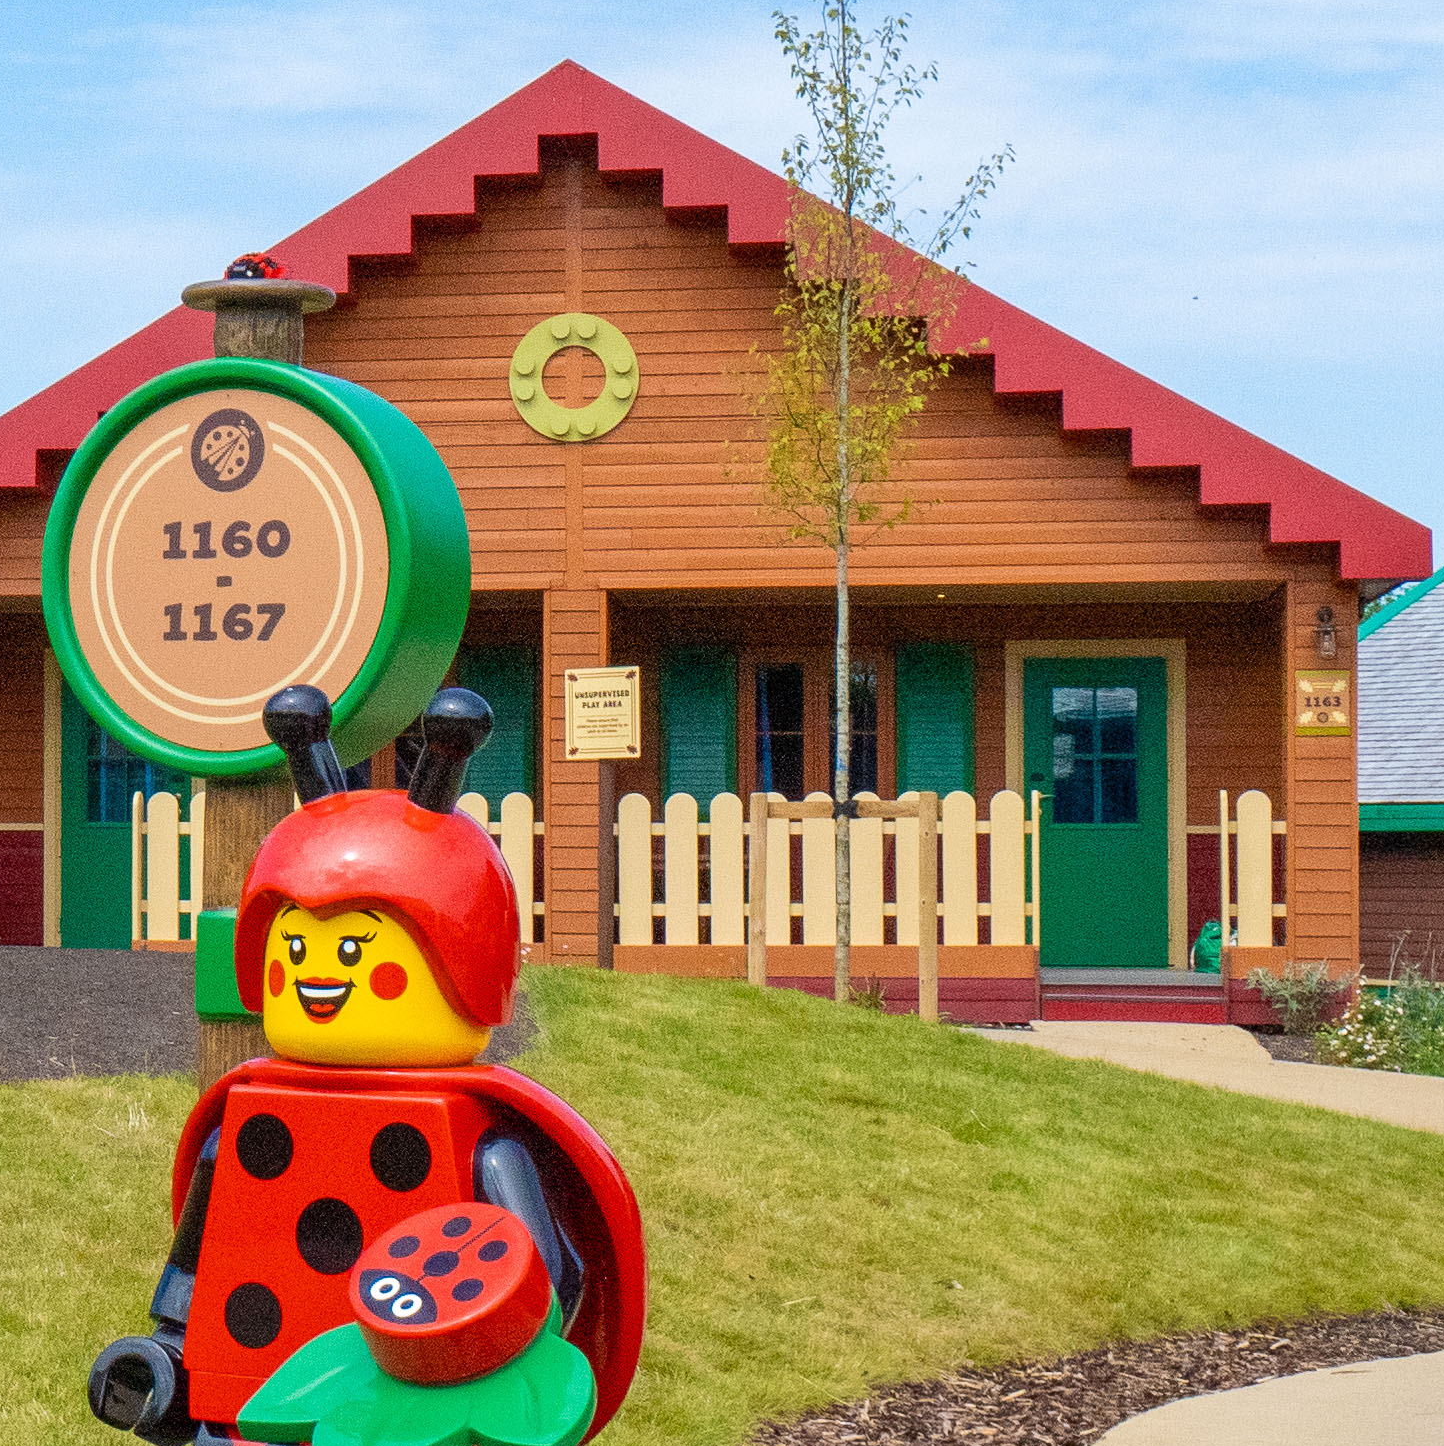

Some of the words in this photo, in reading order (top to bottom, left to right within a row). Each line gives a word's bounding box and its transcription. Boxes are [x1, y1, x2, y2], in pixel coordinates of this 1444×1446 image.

[162, 519, 291, 560] 1160
[162, 602, 287, 642] 1167
[574, 689, 630, 700] UNSUPERVISED
[582, 701, 600, 709] PLAY
[603, 700, 622, 709] AREA
[1304, 696, 1342, 707] 1163
